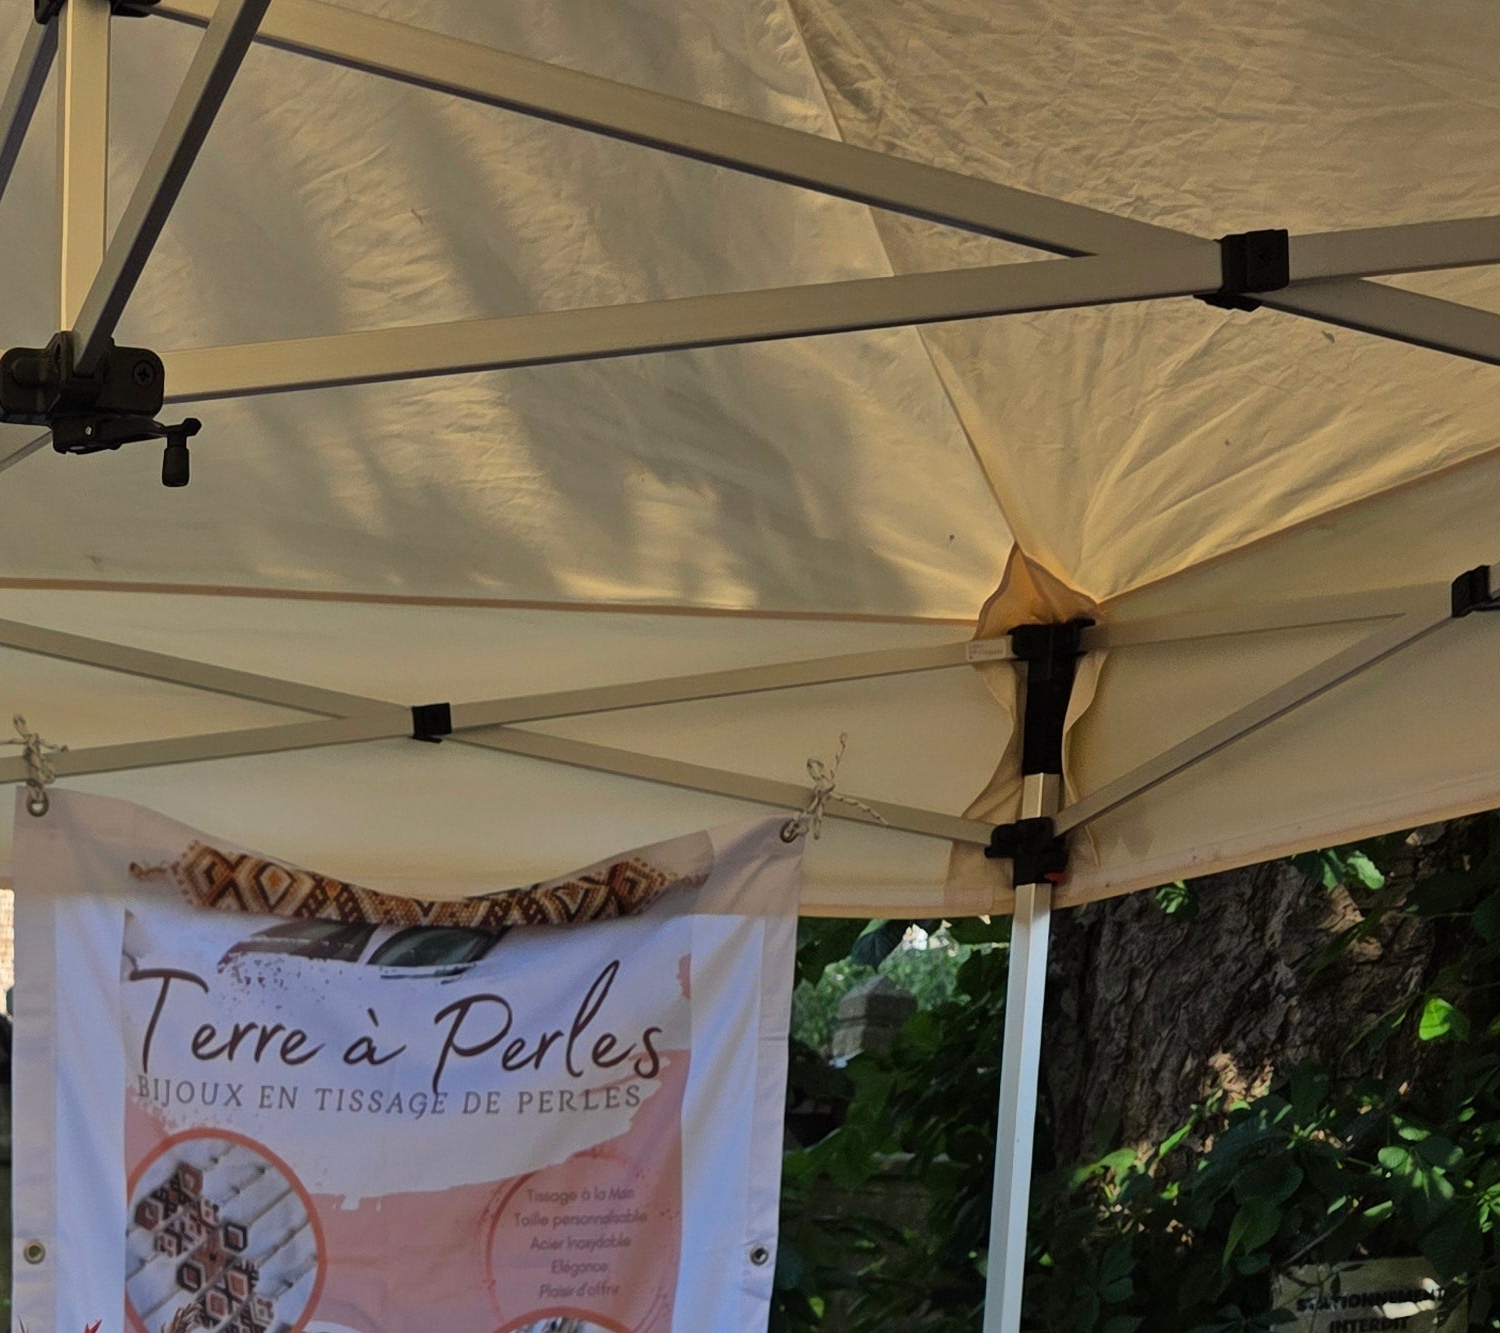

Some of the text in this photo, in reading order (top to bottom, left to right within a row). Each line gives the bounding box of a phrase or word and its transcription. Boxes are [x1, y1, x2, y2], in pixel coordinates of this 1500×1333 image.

[129, 960, 663, 1093] Terre à Perles
[136, 1073, 642, 1121] BIJOUX EN TISSAGE DE PERLES
[527, 1188, 577, 1206] Tissage
[515, 1209, 648, 1229] Taille personnalisable
[530, 1236, 565, 1250] Acier
